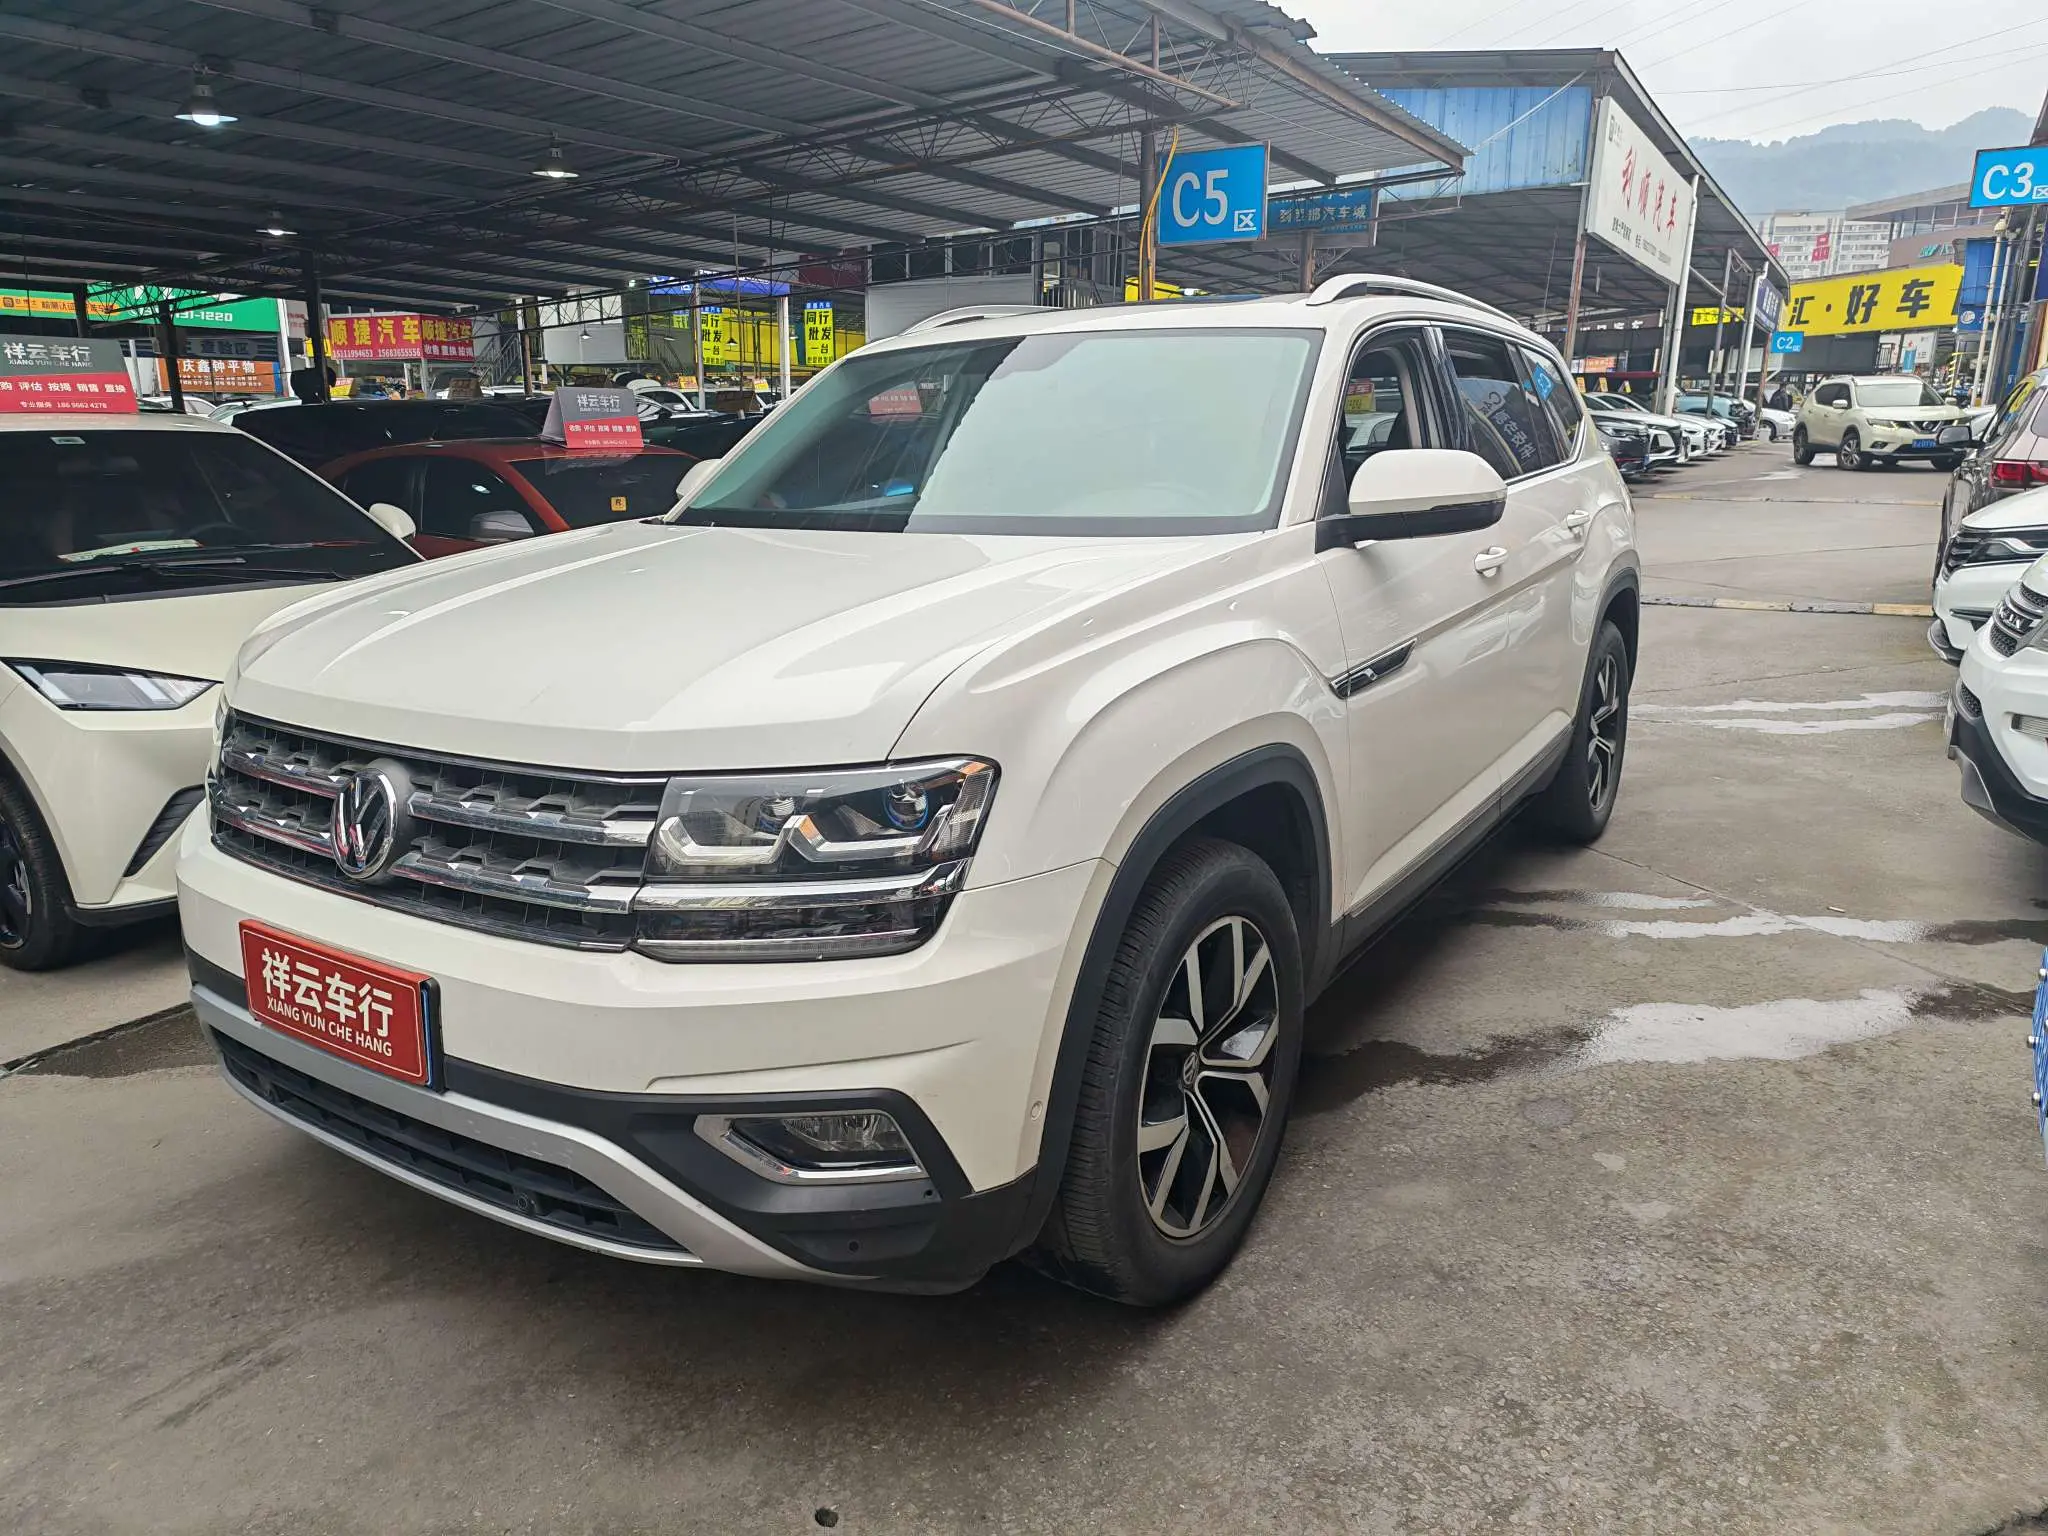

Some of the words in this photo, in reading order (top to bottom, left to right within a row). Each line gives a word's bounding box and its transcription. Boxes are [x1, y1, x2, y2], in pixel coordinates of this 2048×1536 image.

[1173, 168, 1256, 232] C5区
[1622, 145, 1678, 240] 利顺汽车
[806, 311, 830, 325] 同行
[330, 316, 421, 346] 顺捷汽车
[702, 329, 722, 343] 批发
[808, 326, 831, 341] 批发
[3, 341, 92, 362] 祥云车行
[703, 345, 720, 355] 一台
[811, 343, 829, 354] 一台
[19, 381, 43, 392] 评估
[48, 382, 72, 392] 按揭
[76, 383, 99, 393] 销售
[104, 383, 127, 393] 置换
[577, 393, 621, 408] 祥云车行
[261, 947, 393, 1037] 祥云车行
[267, 996, 300, 1021] XIANG
[302, 1011, 326, 1032] YUN
[328, 1021, 352, 1043] CHE
[355, 1035, 393, 1057] HANG
